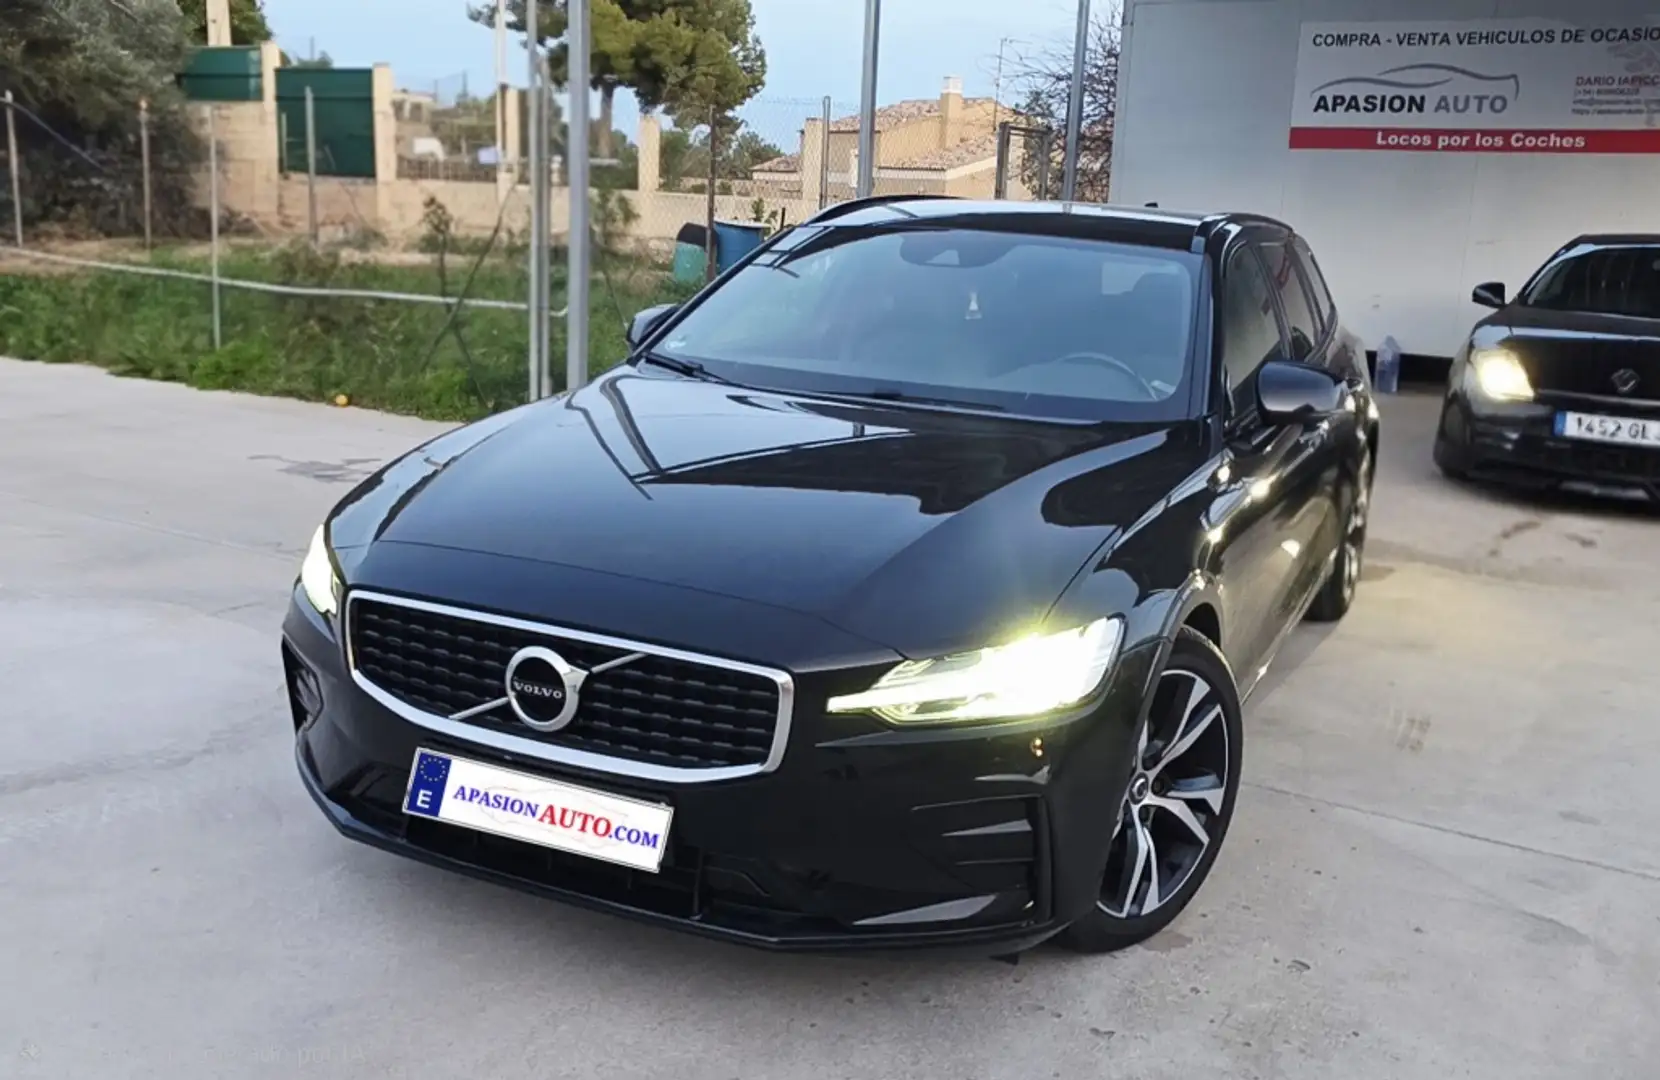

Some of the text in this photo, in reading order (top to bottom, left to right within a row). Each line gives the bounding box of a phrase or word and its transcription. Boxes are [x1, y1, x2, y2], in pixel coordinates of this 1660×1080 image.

[1312, 32, 1382, 47] COMPRA
[1396, 32, 1451, 46] VENTA
[1456, 29, 1556, 45] VEHICULOS
[1560, 29, 1586, 43] DE
[1313, 94, 1508, 114] APASION AUTO
[1376, 131, 1585, 149] Locos por los Coches
[1628, 422, 1660, 440] GL
[513, 680, 562, 699] VOLVO
[415, 788, 433, 809] E
